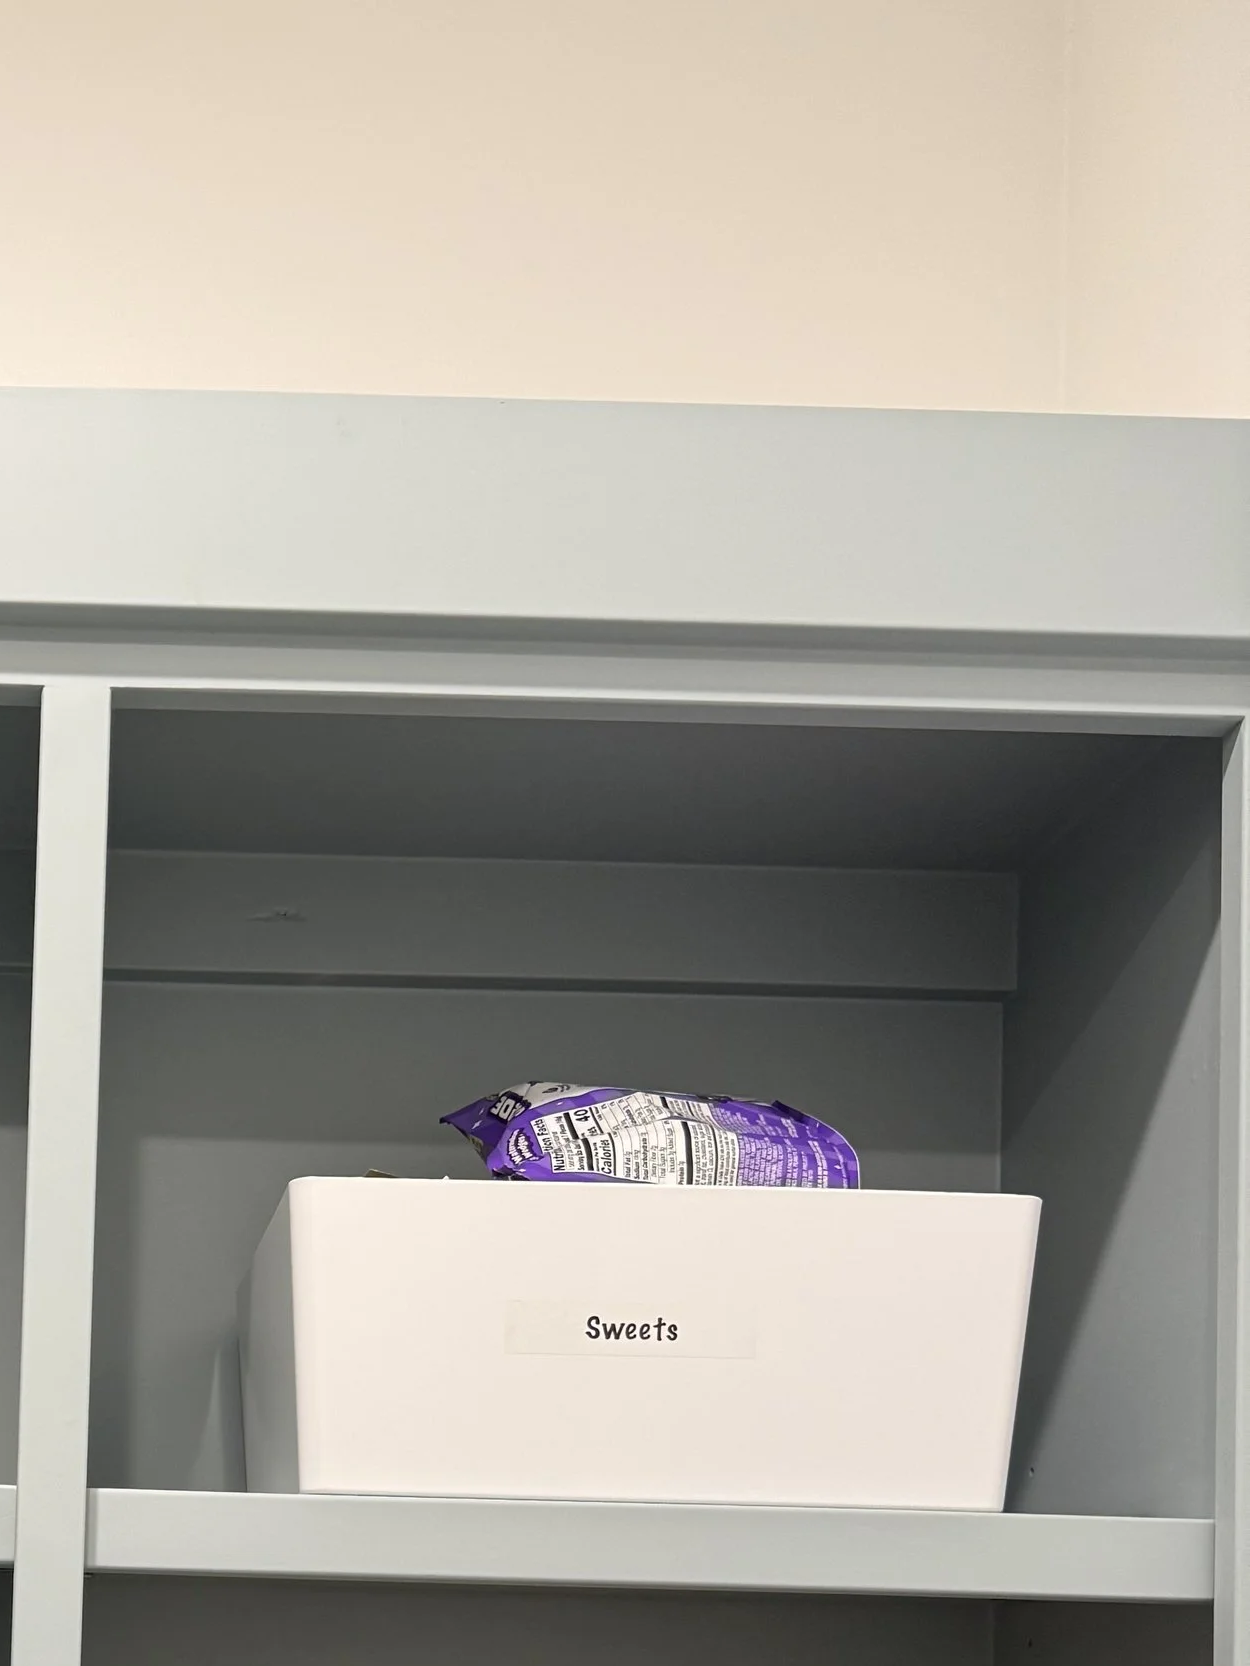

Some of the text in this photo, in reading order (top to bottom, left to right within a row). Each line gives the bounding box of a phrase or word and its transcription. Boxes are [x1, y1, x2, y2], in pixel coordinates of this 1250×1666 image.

[574, 1109, 590, 1122] 40
[599, 1139, 613, 1175] Calories
[586, 1316, 677, 1341] Sweets
